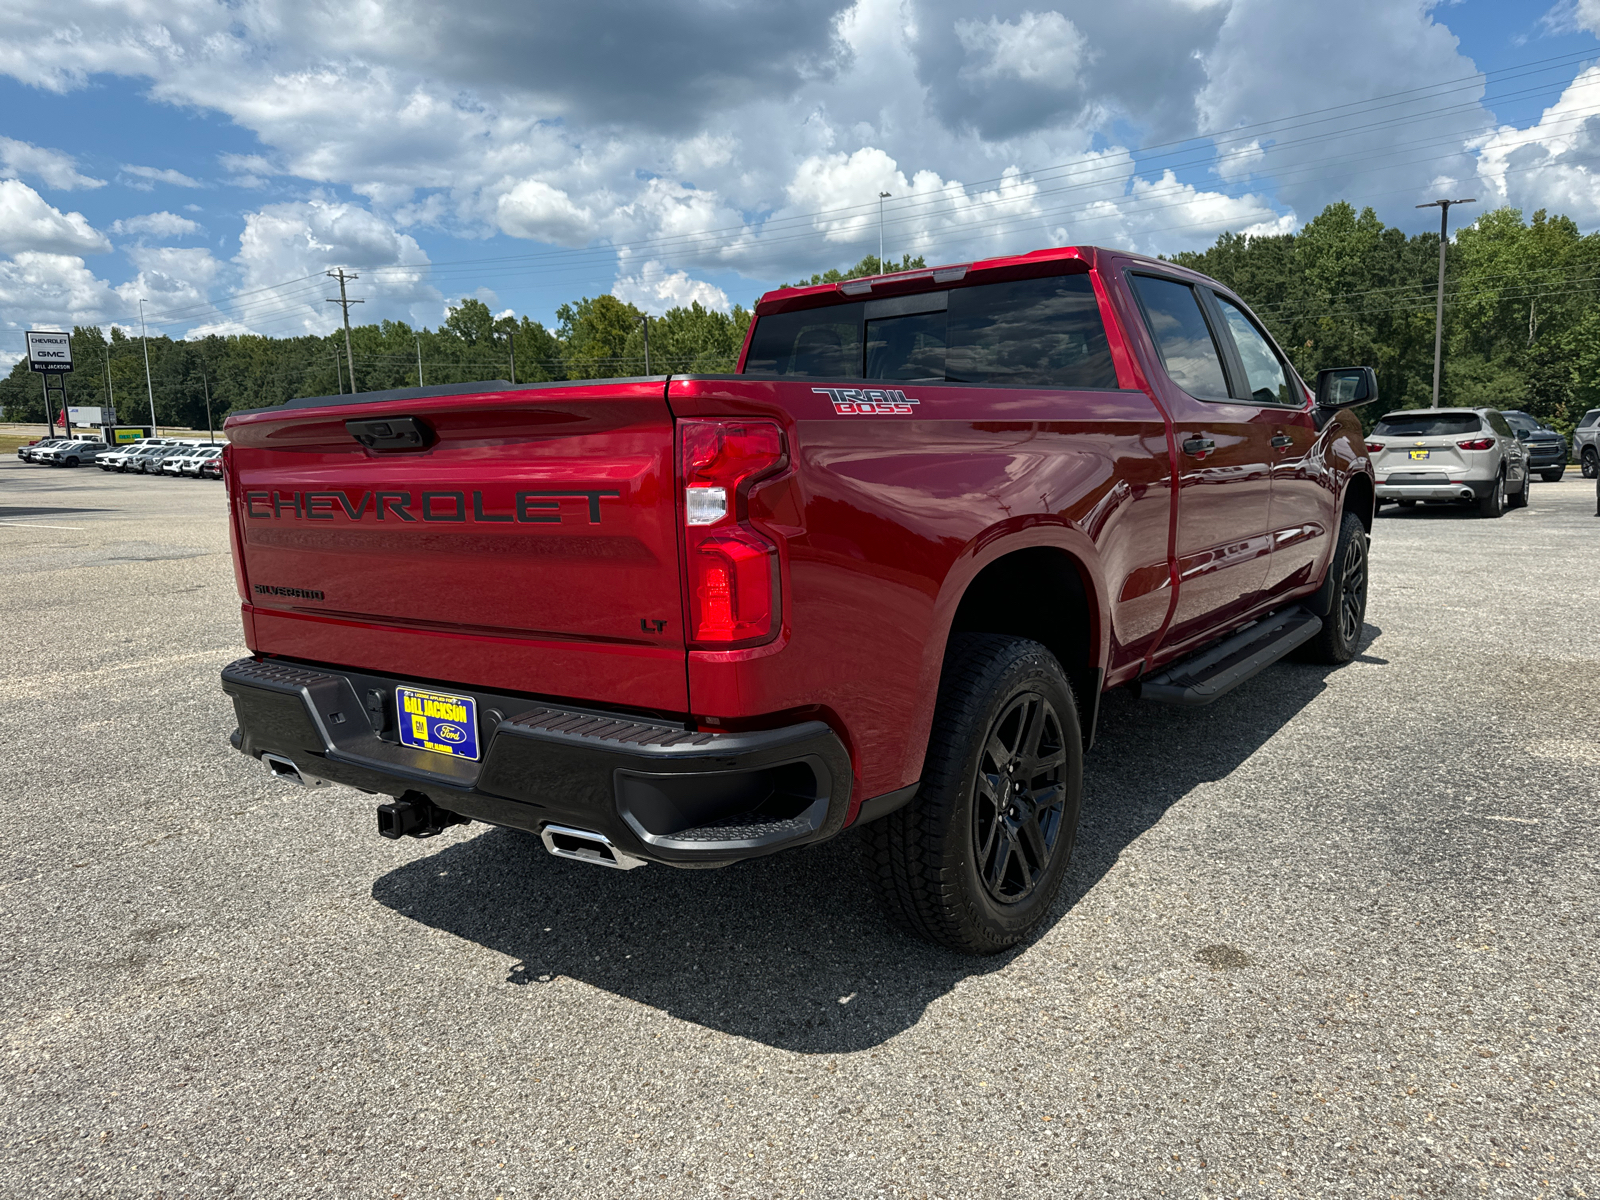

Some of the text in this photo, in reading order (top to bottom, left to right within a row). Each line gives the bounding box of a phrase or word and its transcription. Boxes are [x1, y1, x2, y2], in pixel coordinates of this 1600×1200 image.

[811, 387, 920, 405] TRAIL
[833, 402, 913, 415] BOSS
[246, 490, 620, 525] CHEVROLET
[254, 584, 325, 602] SILVERADO
[640, 618, 668, 635] LT
[404, 696, 467, 723] BILL JACKSON
[416, 720, 424, 733] GM
[440, 725, 460, 740] Ford
